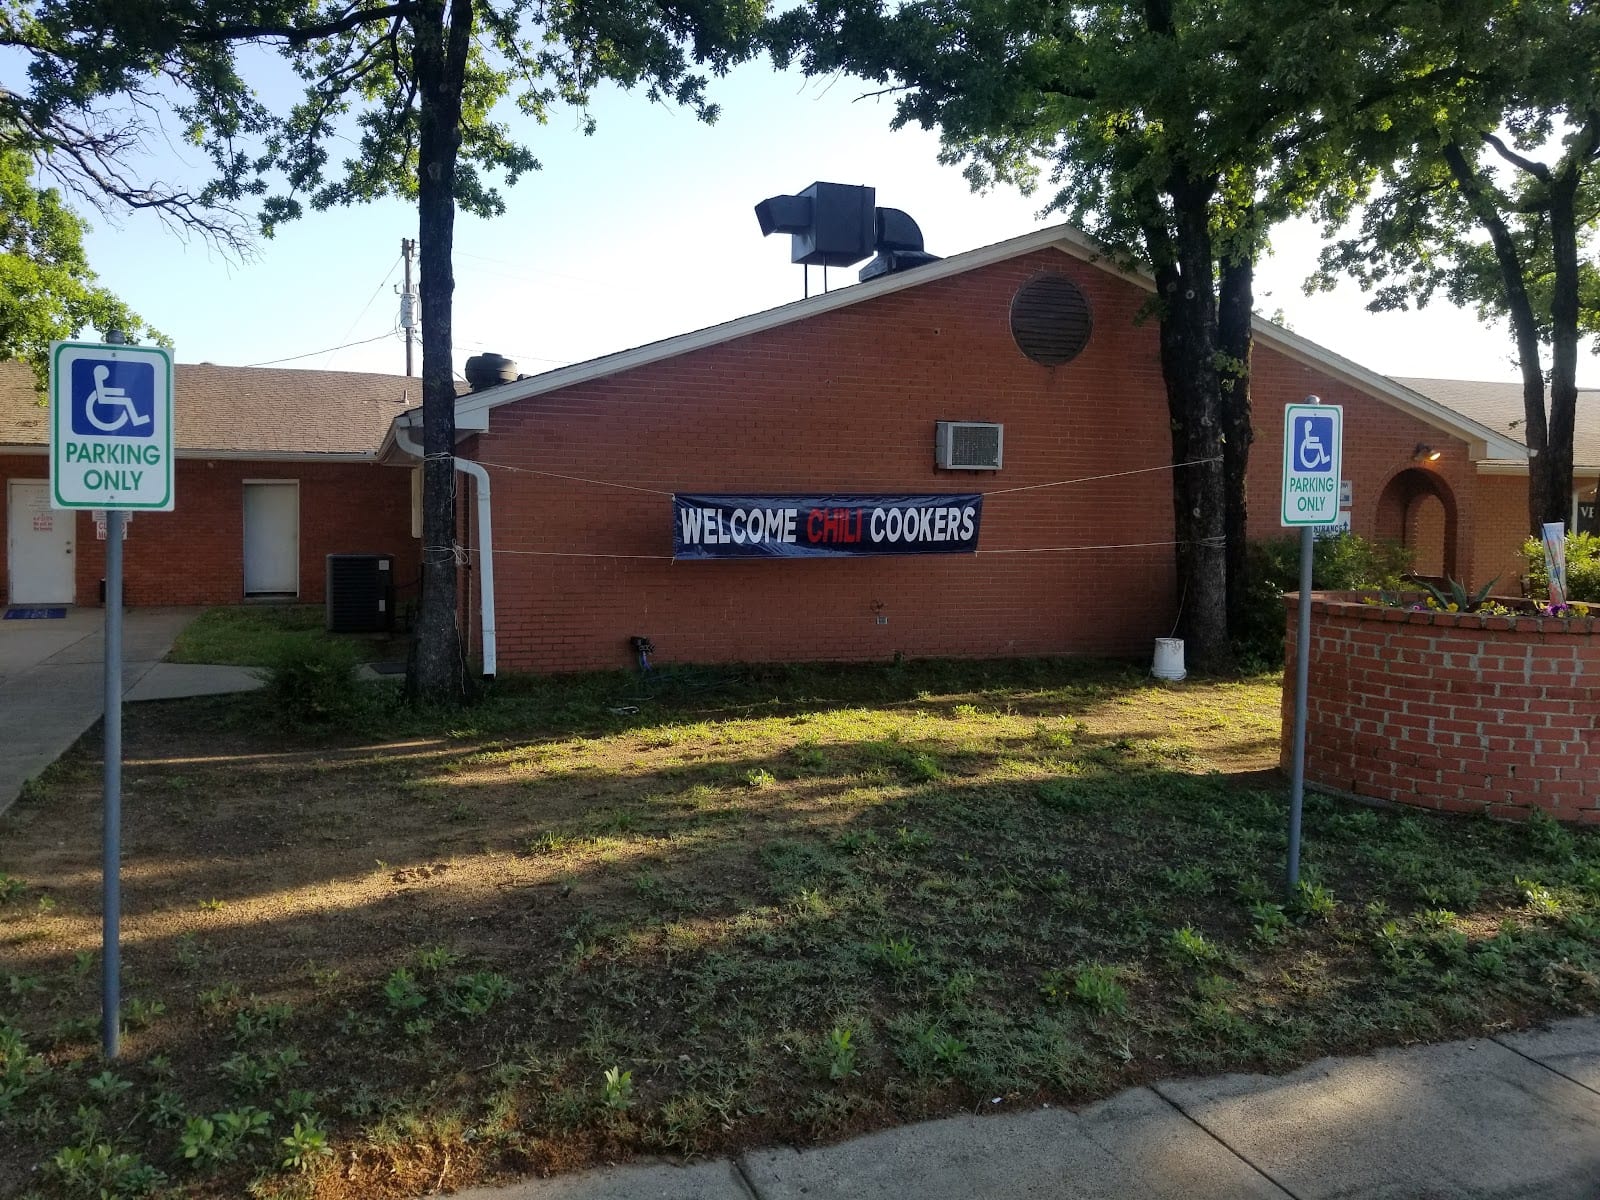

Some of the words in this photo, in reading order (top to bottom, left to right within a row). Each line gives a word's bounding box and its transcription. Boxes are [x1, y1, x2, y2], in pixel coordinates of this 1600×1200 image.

[66, 442, 161, 465] PARKING
[83, 468, 144, 491] ONLY
[1289, 477, 1334, 492] PARKING
[1297, 496, 1326, 512] ONLY
[680, 507, 798, 545] WELCOME
[807, 508, 863, 543] CHILI
[870, 506, 976, 543] COOKERS
